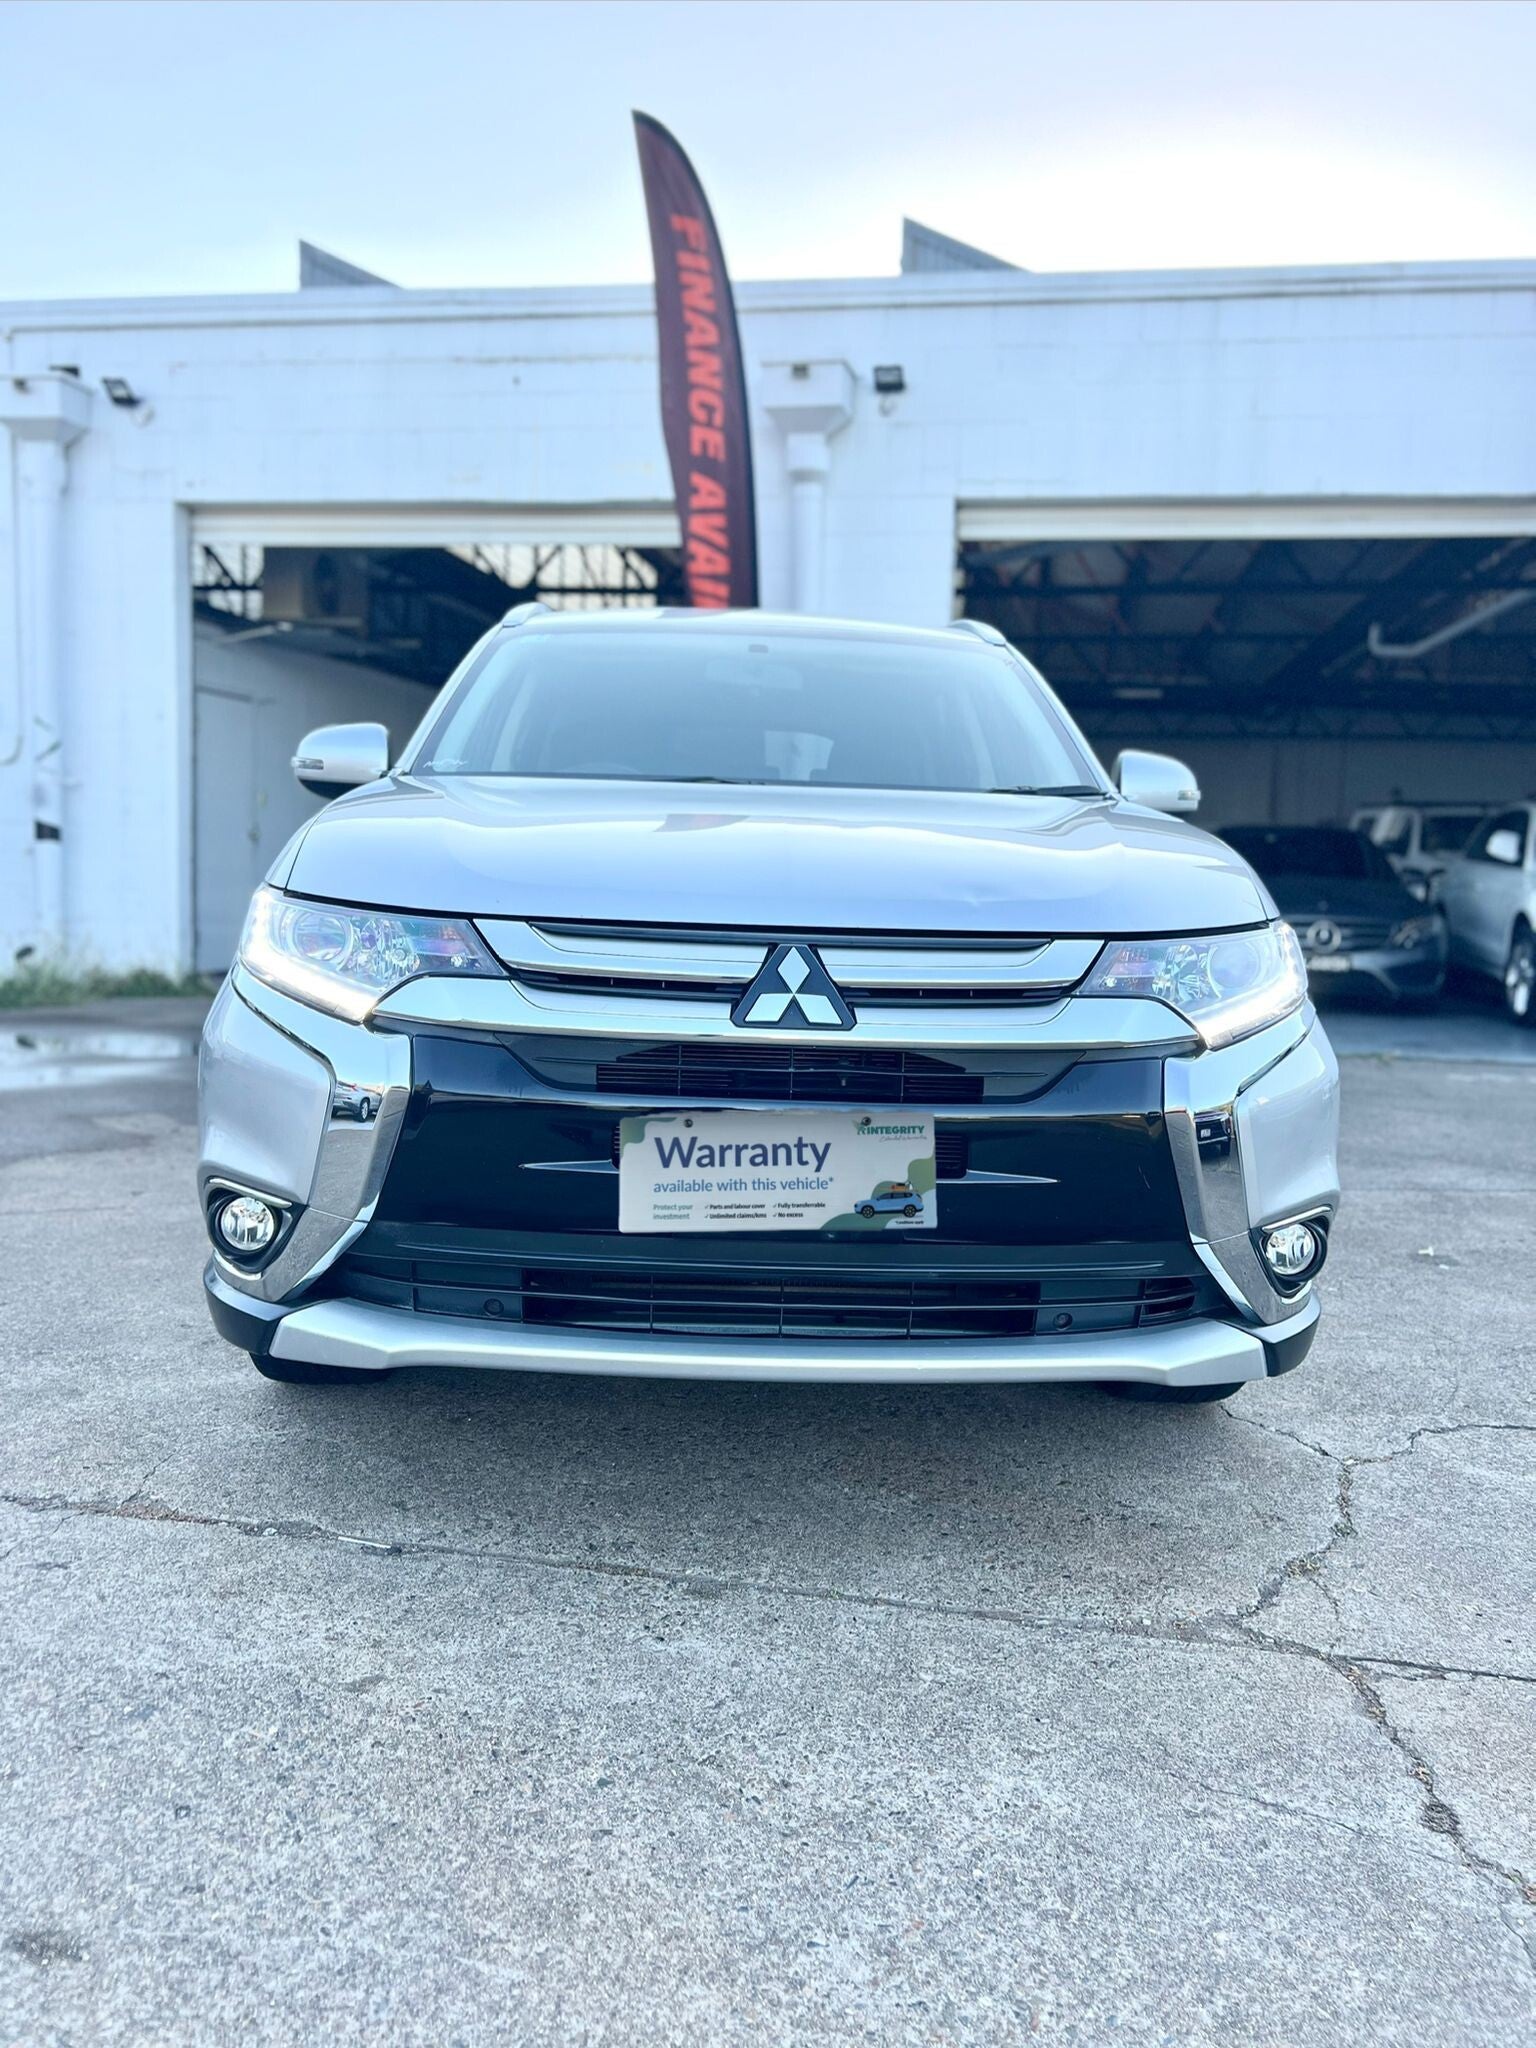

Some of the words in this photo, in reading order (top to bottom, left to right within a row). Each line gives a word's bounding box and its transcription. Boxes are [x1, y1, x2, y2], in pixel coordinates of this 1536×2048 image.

[671, 213, 725, 462] FINANCE
[866, 1125, 925, 1135] INTEGRITY
[654, 1136, 832, 1173] Warranty
[653, 1179, 713, 1193] available
[716, 1178, 748, 1192] with
[751, 1177, 777, 1191] this
[678, 1204, 693, 1212] your
[777, 1203, 790, 1211] Fully
